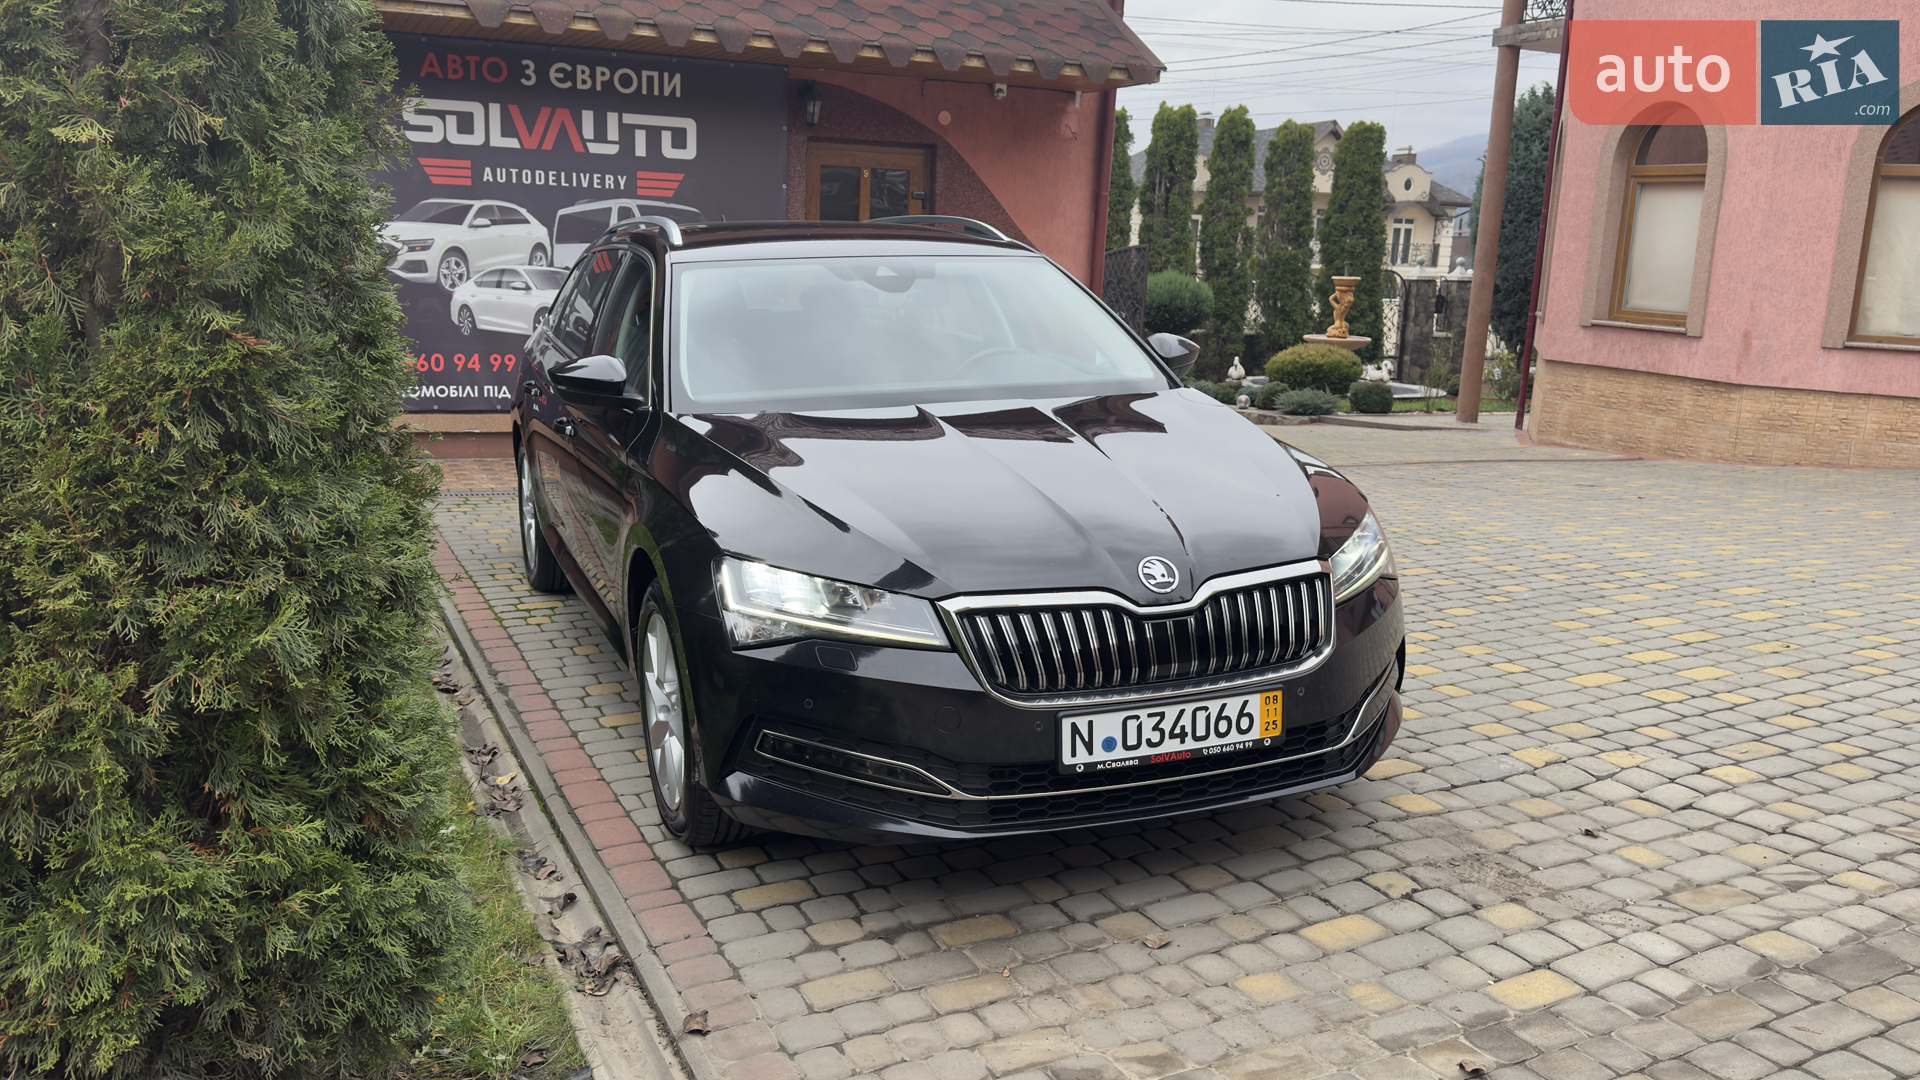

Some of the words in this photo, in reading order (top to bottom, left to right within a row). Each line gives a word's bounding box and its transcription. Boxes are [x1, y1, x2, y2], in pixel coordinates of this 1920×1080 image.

[420, 52, 508, 84] АВТО
[520, 59, 537, 86] З
[549, 62, 682, 98] ЄВРОПИ
[402, 97, 698, 160] SOLVAUTO
[482, 166, 628, 191] AUTODELIVERY
[453, 353, 481, 373] 94
[489, 353, 517, 373] 99
[401, 385, 479, 398] ОМОБІЛІ
[484, 385, 512, 399] ПІД
[1264, 694, 1279, 706] 08
[1266, 707, 1278, 718] 11
[1070, 719, 1094, 758] N
[1121, 699, 1255, 752] 034066
[1264, 719, 1279, 732] 25
[1208, 746, 1221, 754] 050
[1222, 744, 1235, 752] 660
